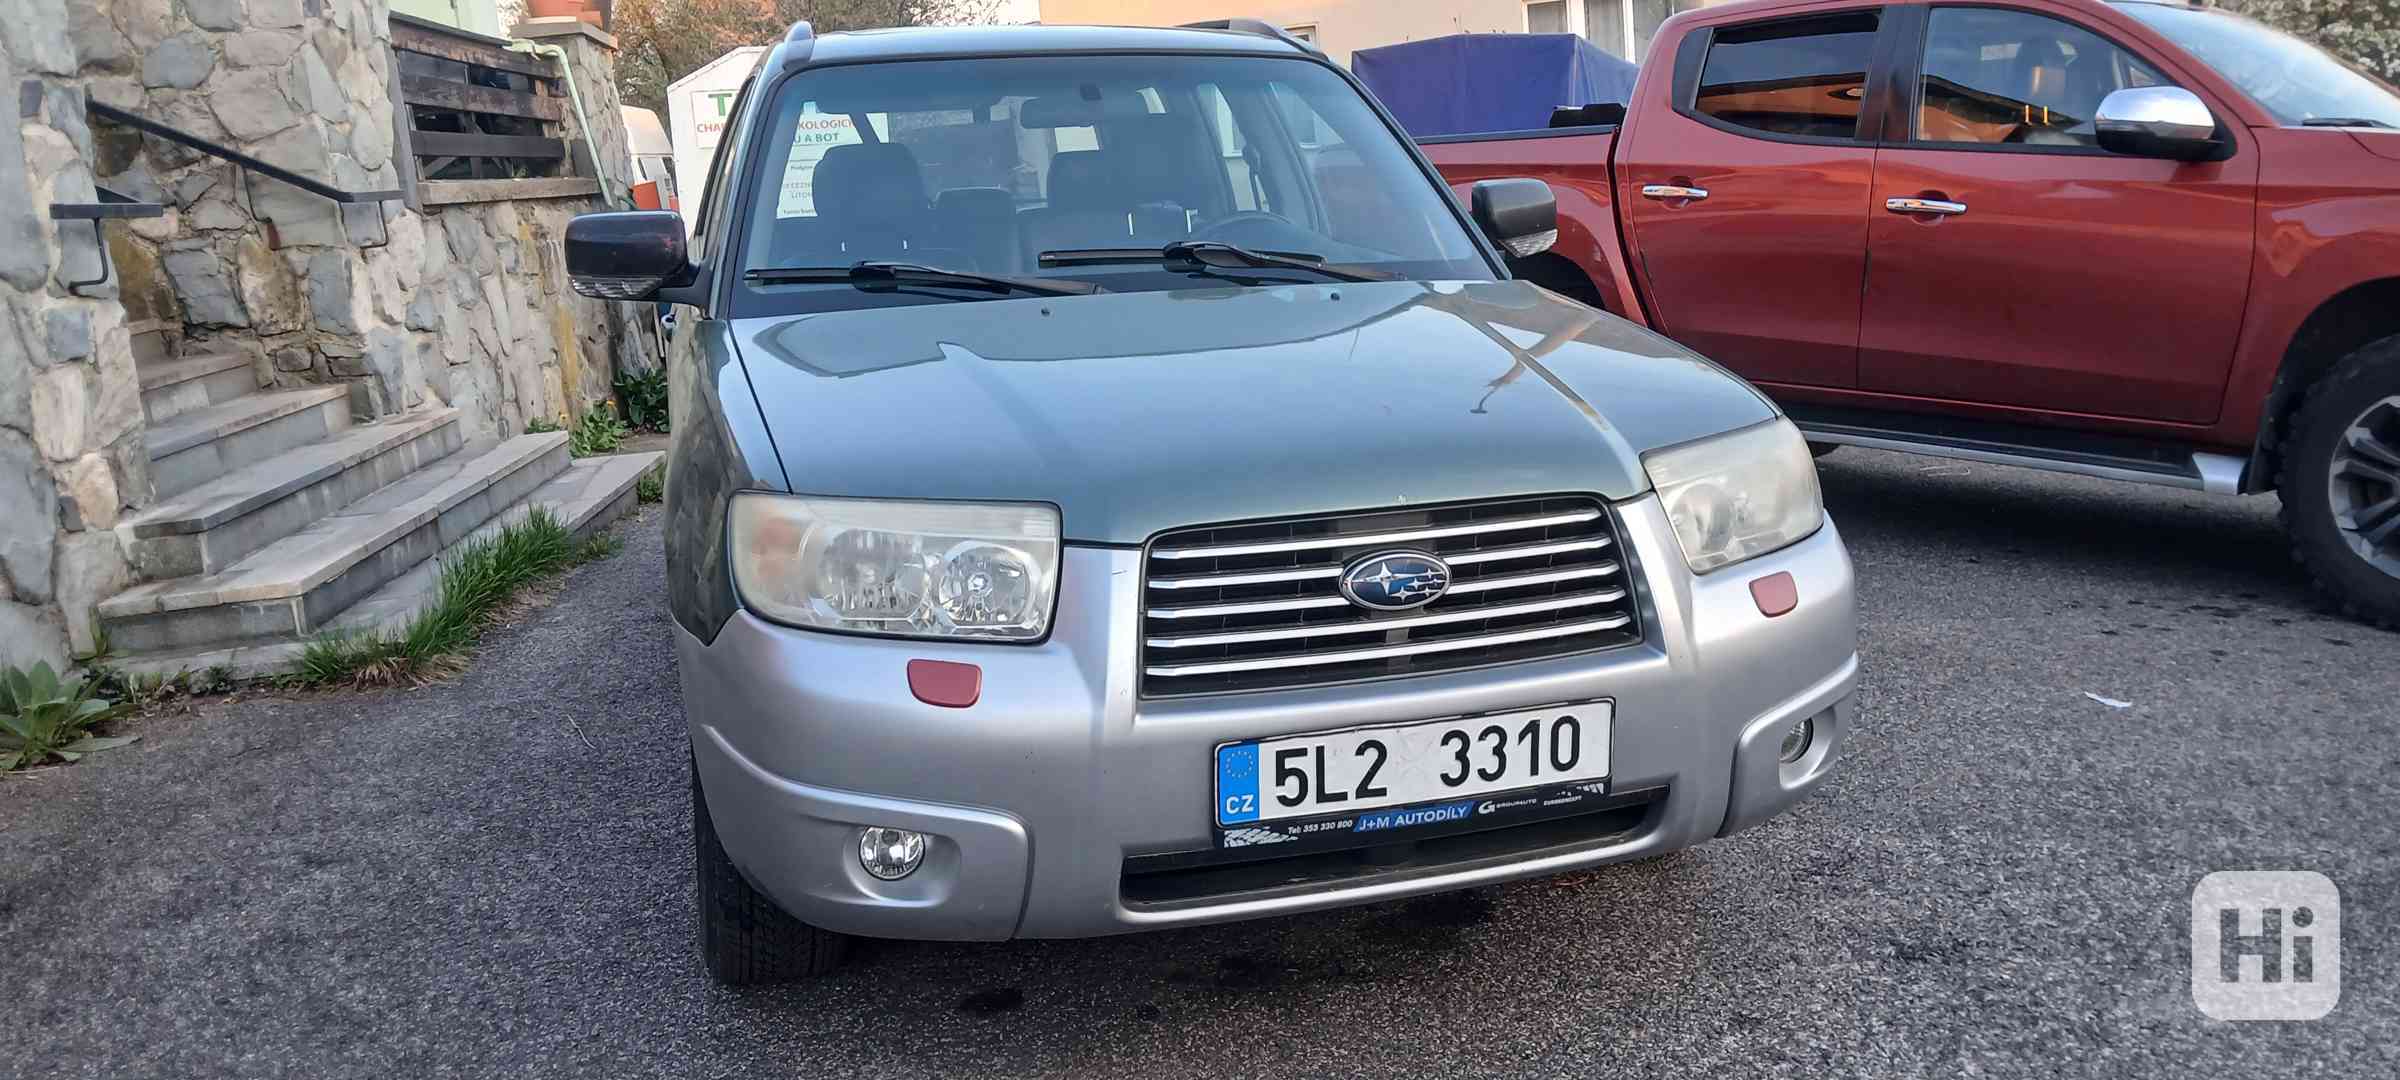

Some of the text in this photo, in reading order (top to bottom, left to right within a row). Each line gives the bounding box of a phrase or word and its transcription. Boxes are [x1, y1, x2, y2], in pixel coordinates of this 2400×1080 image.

[816, 133, 840, 143] BOT
[1275, 715, 1581, 807] 5L2 3310
[1226, 794, 1254, 814] CZ
[1359, 817, 1390, 831] J+M
[1394, 805, 1468, 826] AUTODÍLY
